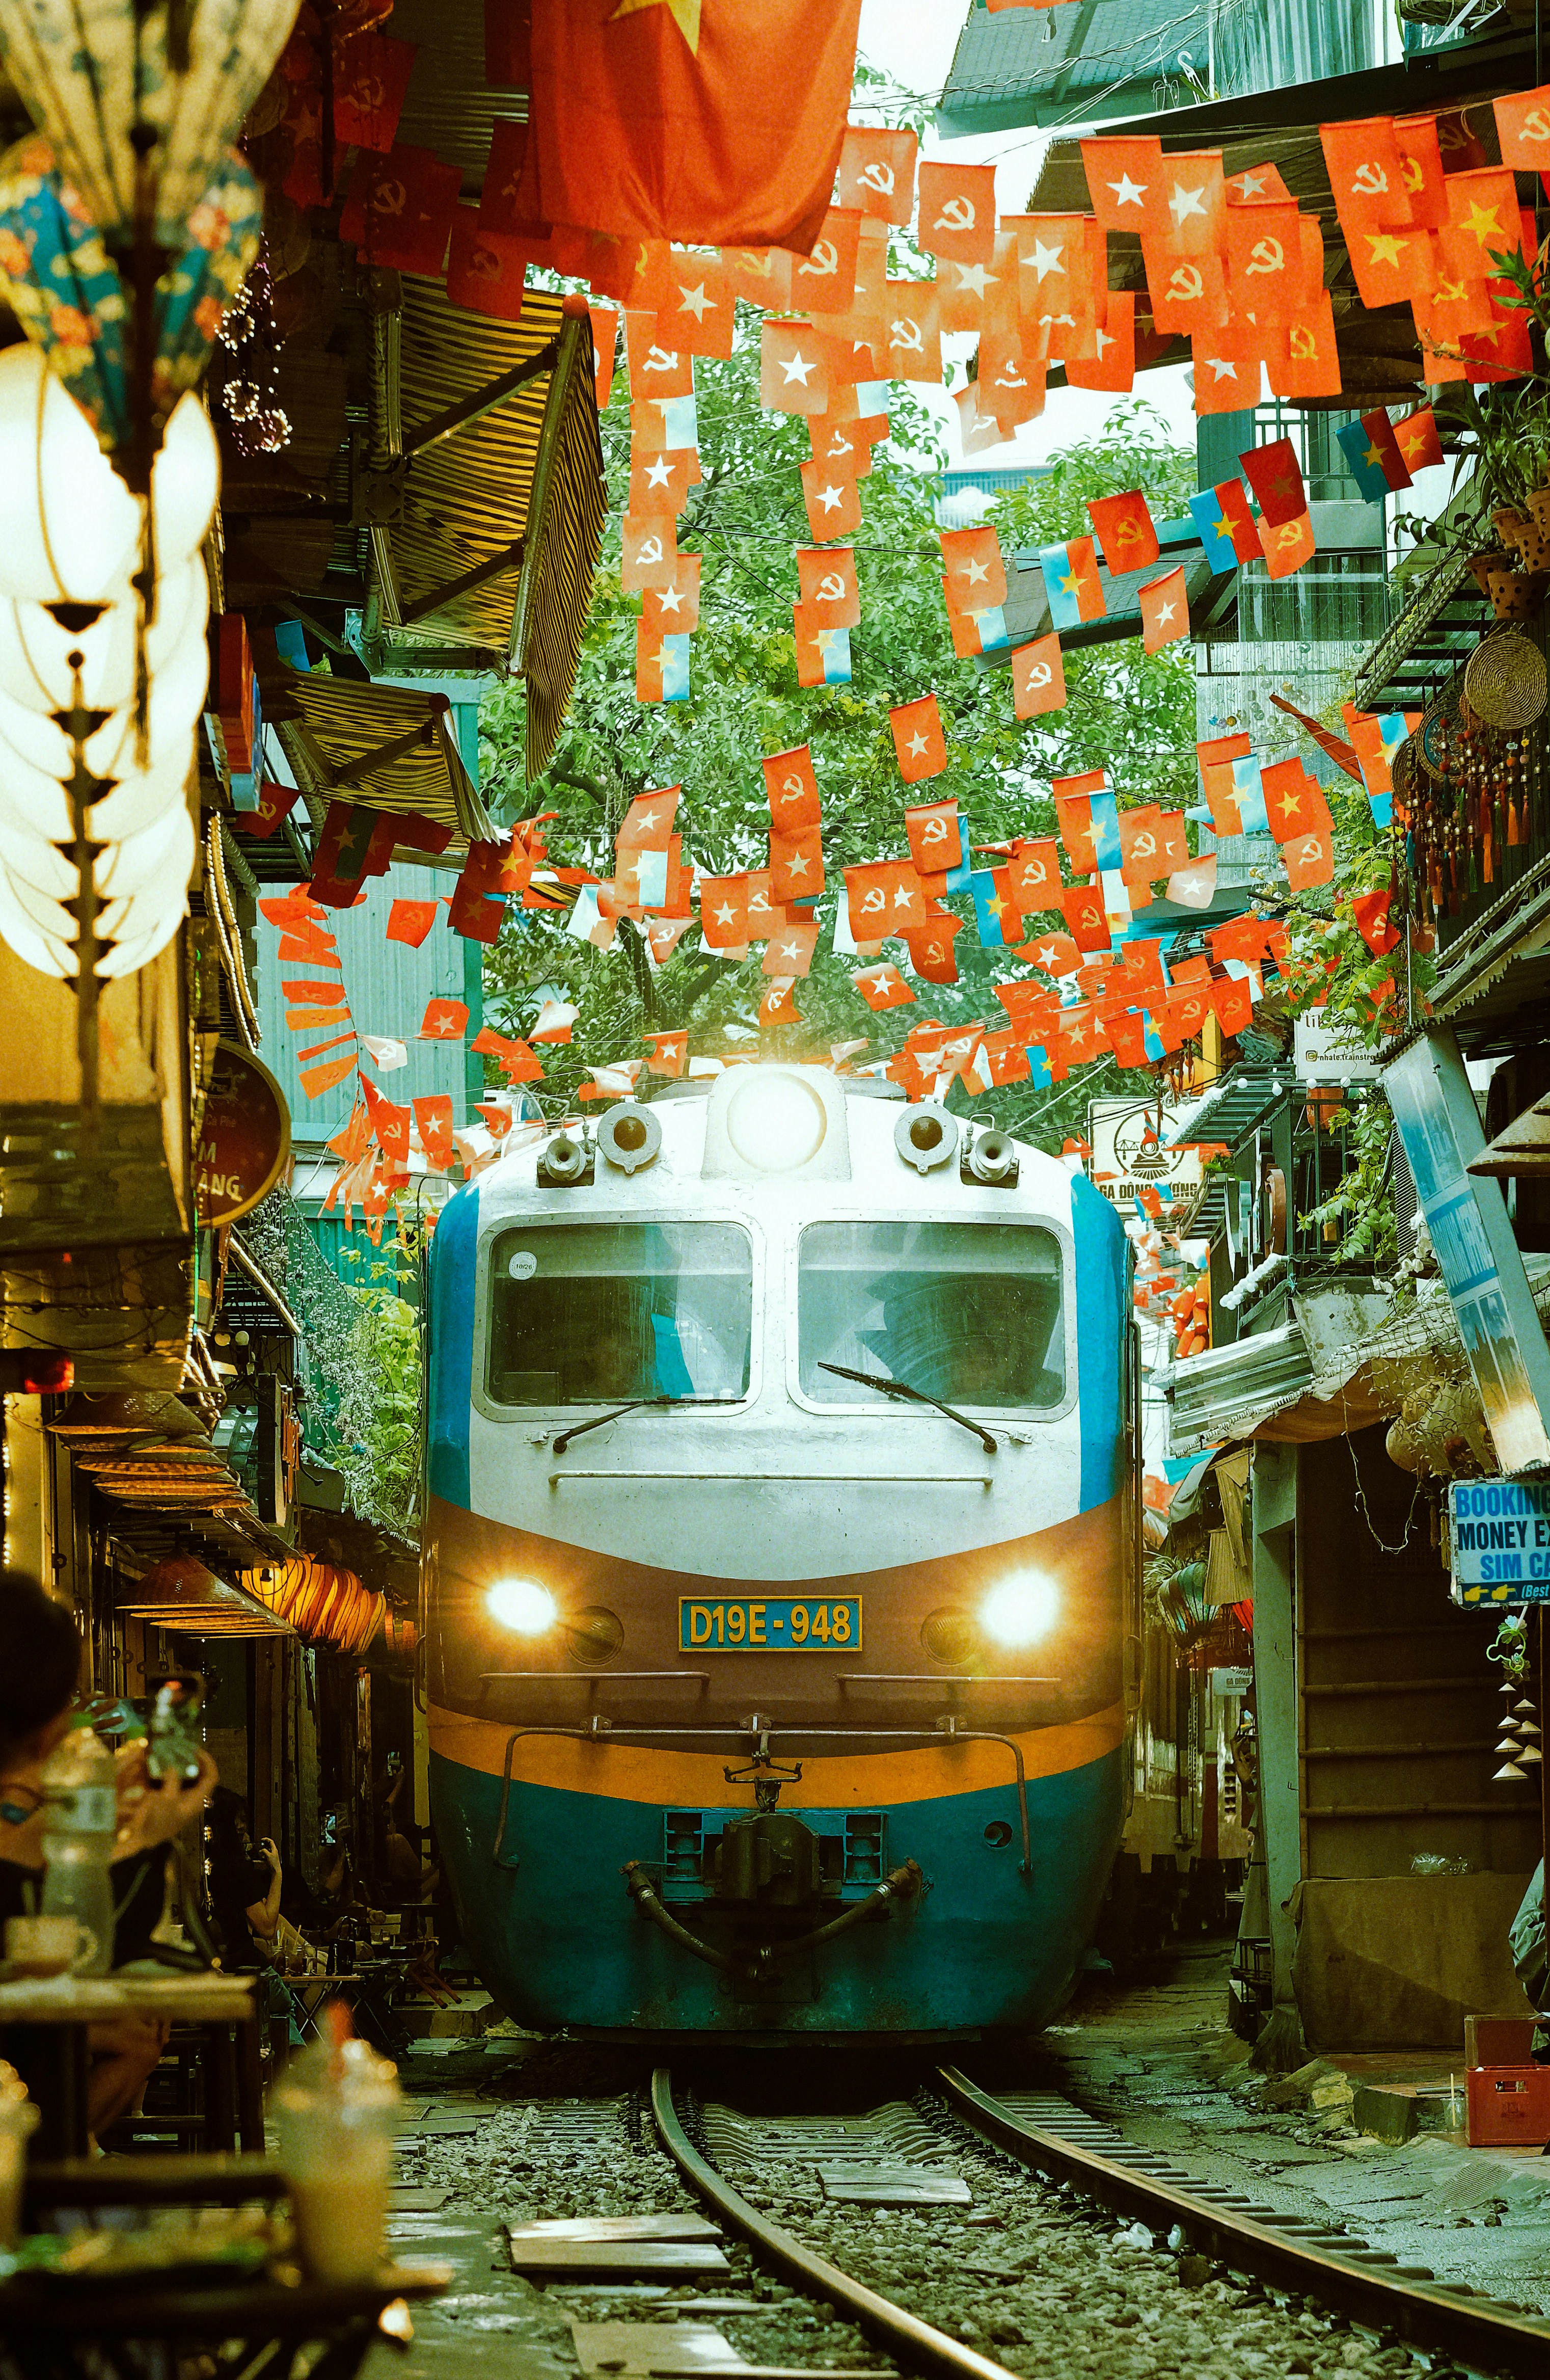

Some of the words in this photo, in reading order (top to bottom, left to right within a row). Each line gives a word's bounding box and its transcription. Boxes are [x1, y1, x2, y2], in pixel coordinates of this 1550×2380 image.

[197, 1168, 243, 1202] ÀNG
[1099, 1185, 1115, 1199] GA
[1457, 1520, 1528, 1550] MONEY
[1480, 1554, 1521, 1580] SIM
[1521, 1584, 1549, 1599] (Best
[690, 1605, 767, 1643] D19E
[791, 1605, 851, 1643] 948
